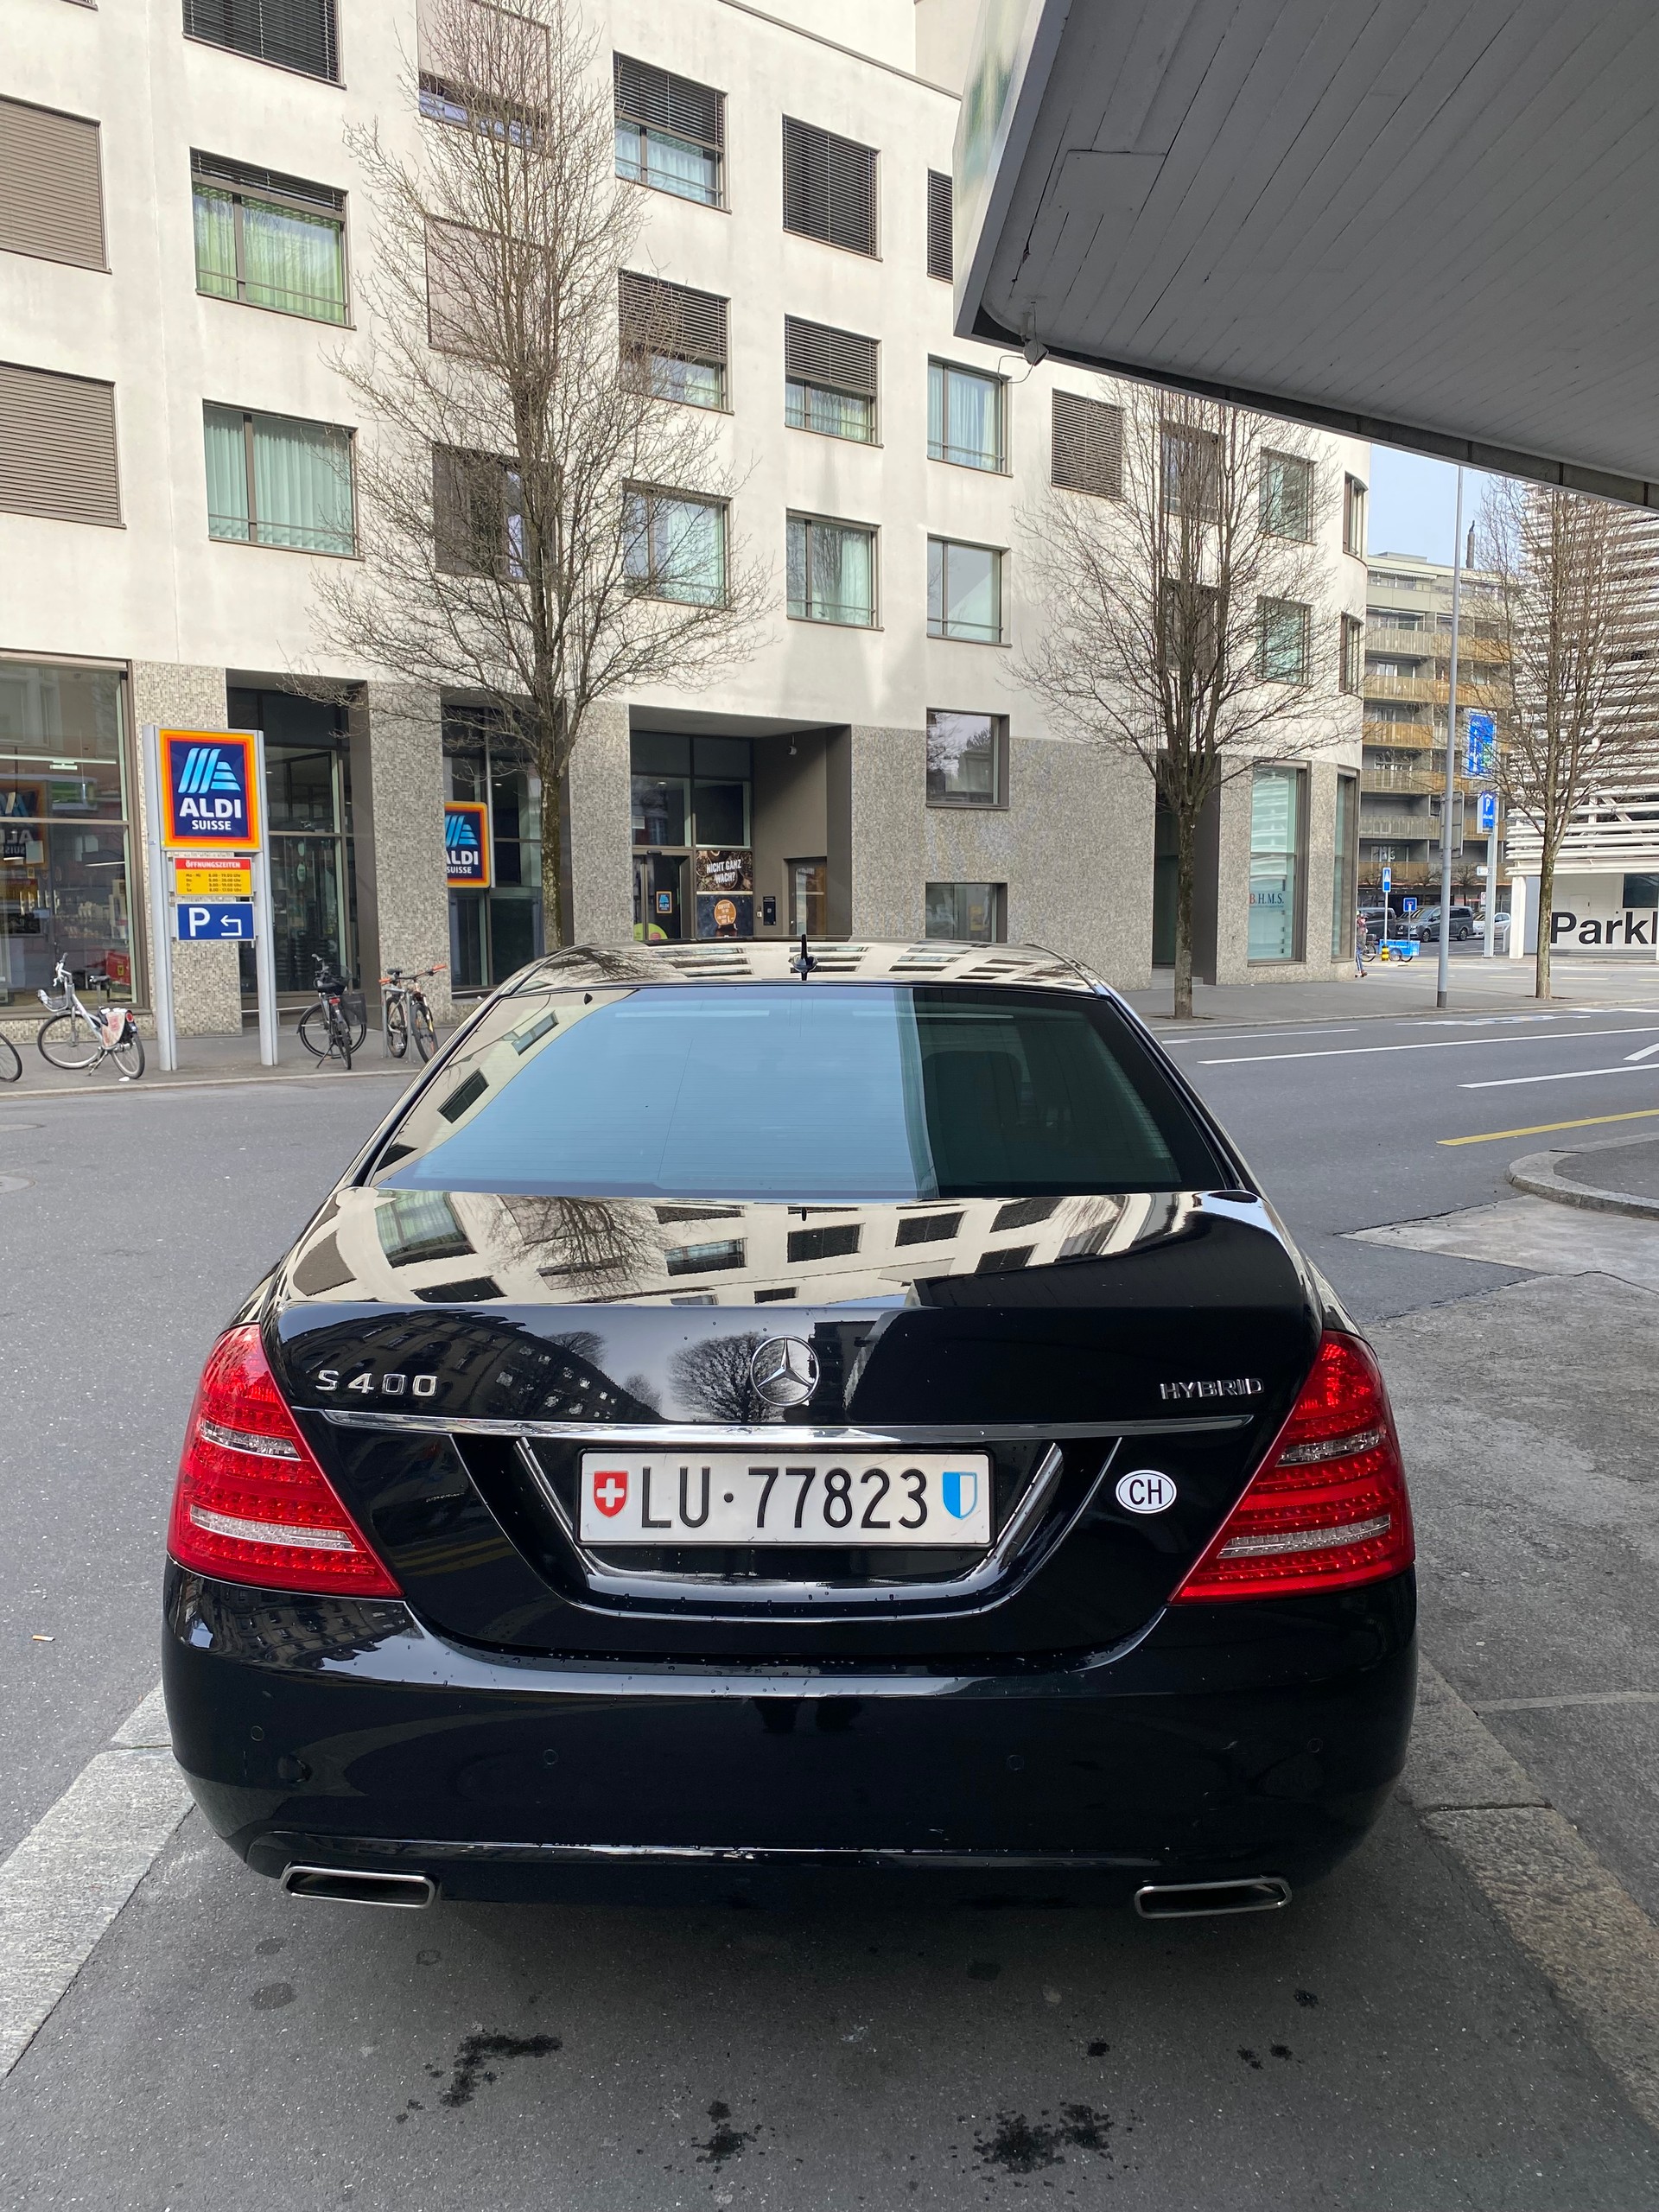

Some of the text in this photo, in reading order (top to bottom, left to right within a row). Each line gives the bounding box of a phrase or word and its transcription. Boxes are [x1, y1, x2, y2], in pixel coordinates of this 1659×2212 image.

[179, 798, 242, 818] ALDI
[192, 820, 232, 830] SUISSE
[185, 860, 241, 868] ÖFFNUNGSZEITEN
[706, 859, 742, 874] NICHT GANZ
[715, 872, 736, 884] WACH?
[1249, 893, 1285, 905] B.H.M.S.
[188, 906, 211, 938] P
[1160, 1378, 1264, 1400] HYBRID
[1129, 1479, 1162, 1505] CH
